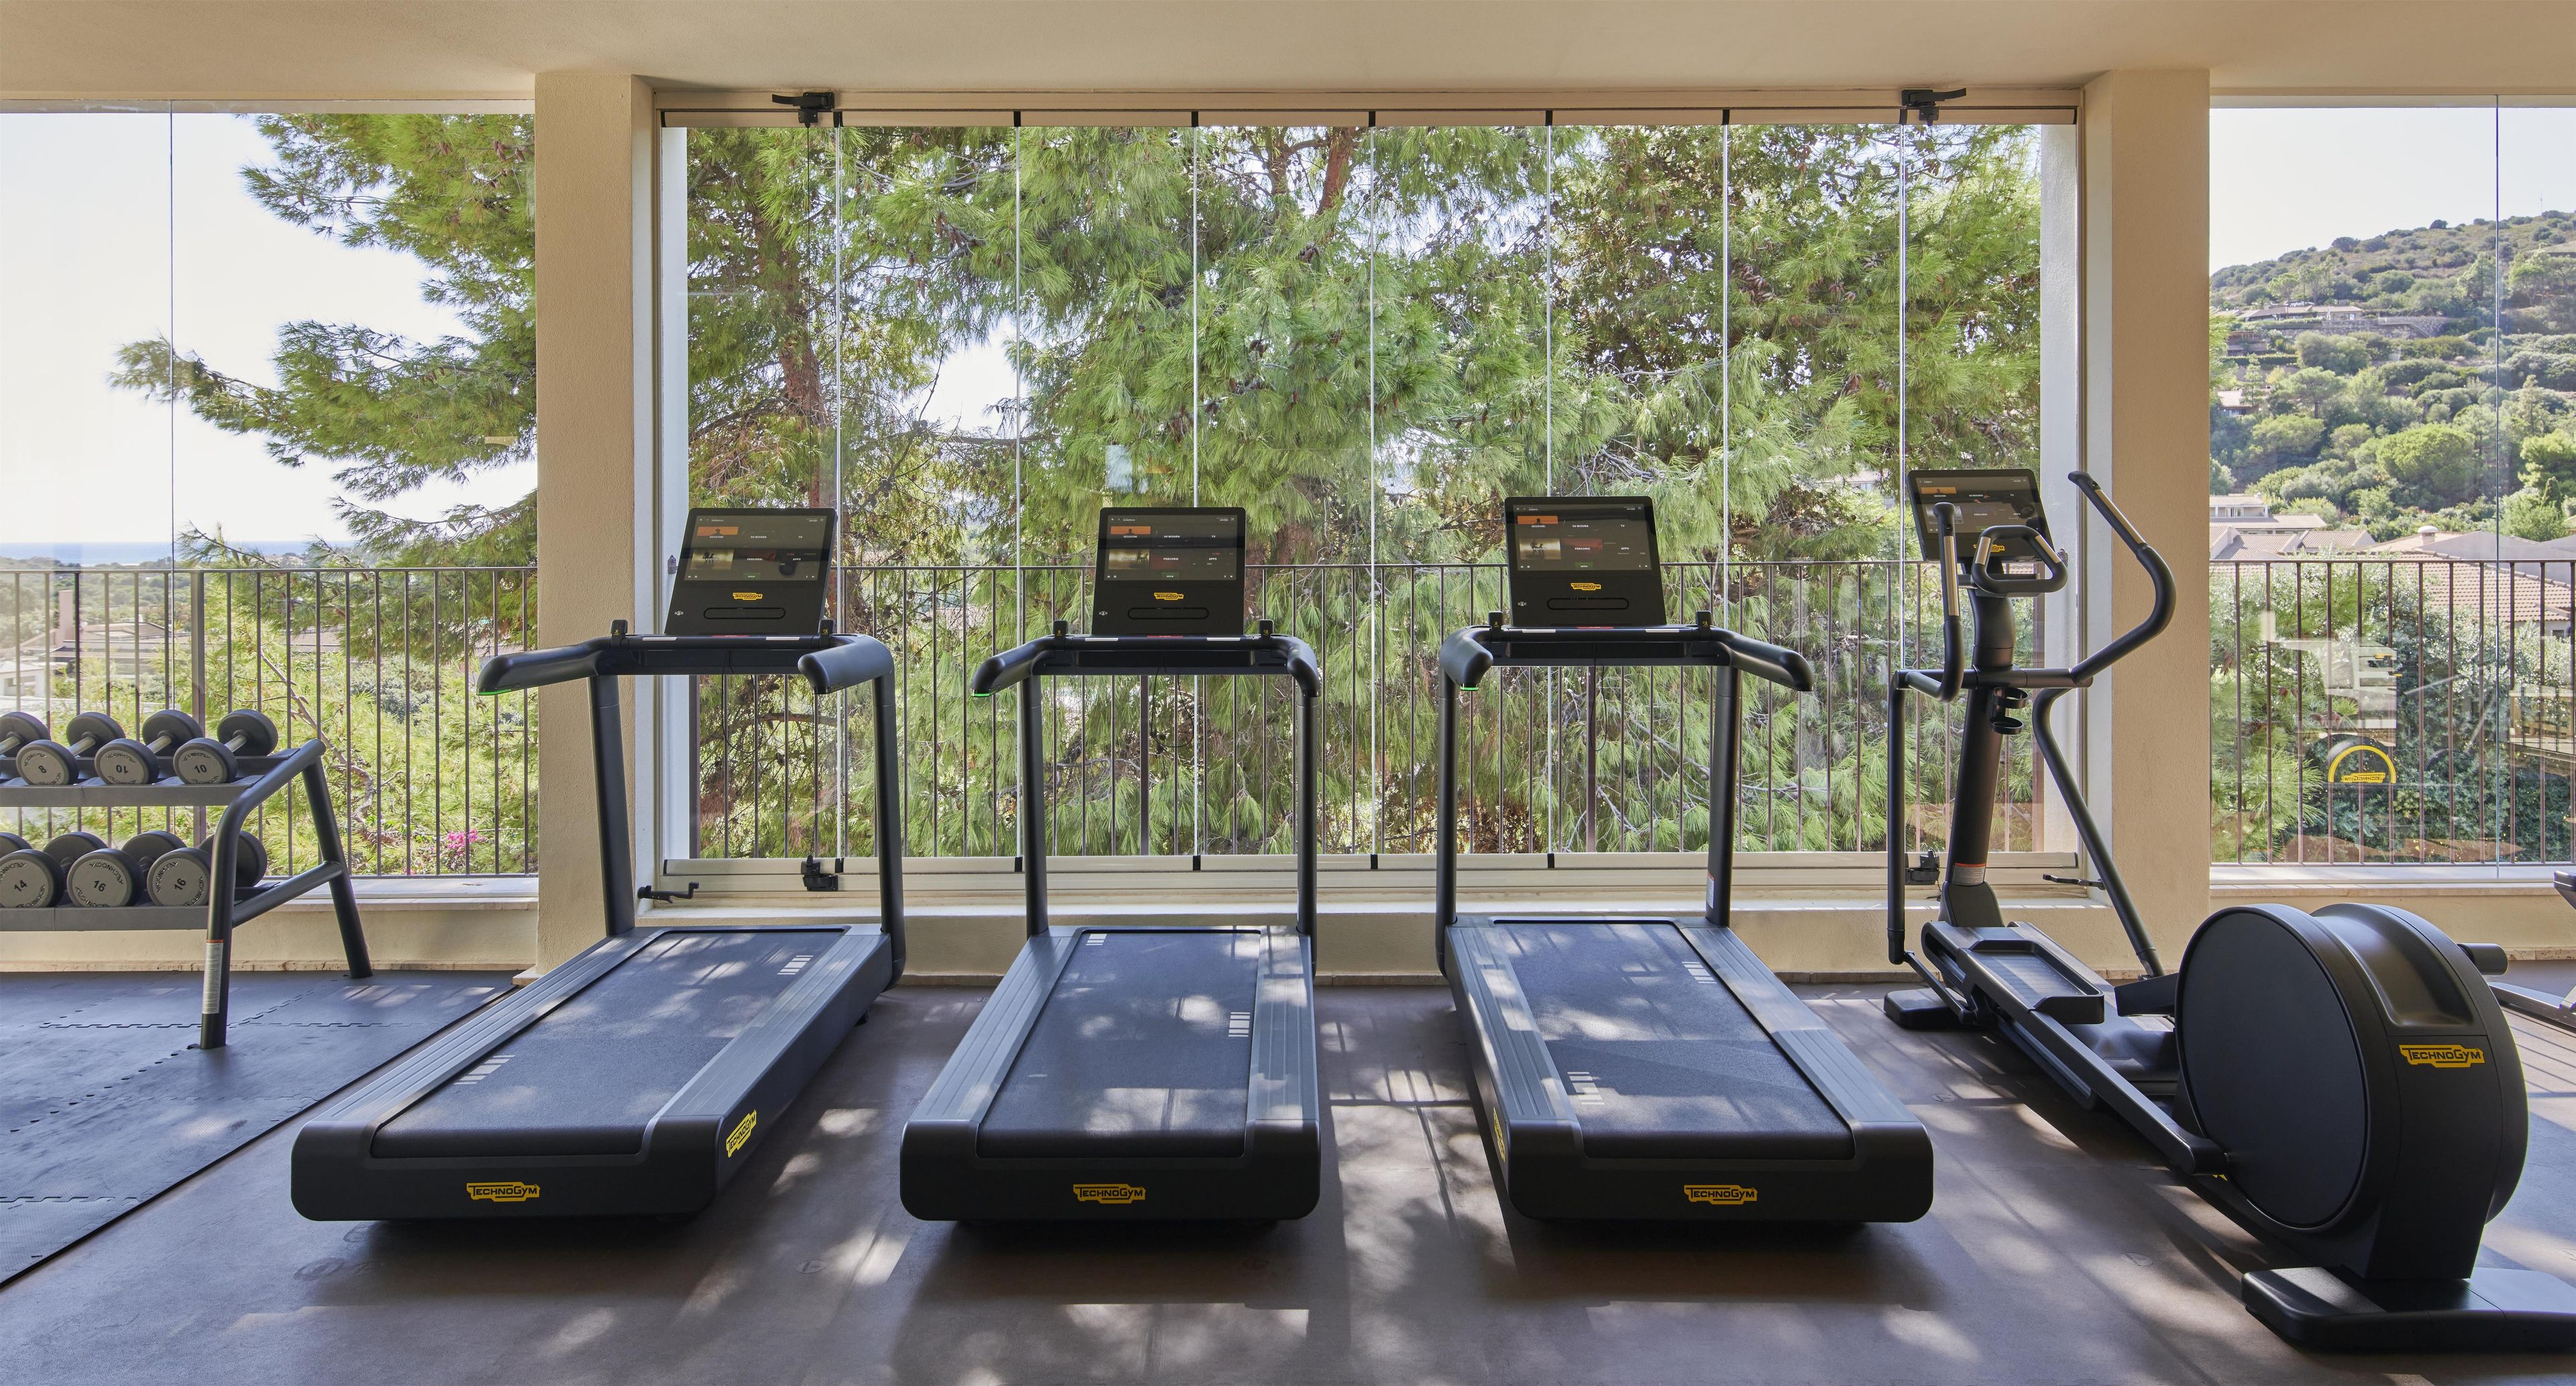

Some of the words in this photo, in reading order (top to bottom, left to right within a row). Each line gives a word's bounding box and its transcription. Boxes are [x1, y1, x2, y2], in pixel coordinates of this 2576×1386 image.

[38, 765, 47, 774] 8
[194, 765, 207, 774] 10
[14, 879, 28, 892] 14
[93, 880, 106, 892] 16
[174, 878, 186, 890] 16
[2402, 1047, 2481, 1063] TECHNOGYM
[727, 1114, 756, 1154] TECHNOGYM
[468, 1184, 537, 1199] TECHNOGYM
[1075, 1185, 1143, 1200] TECHNOGYM
[1685, 1187, 1755, 1202] TECHNOGYM
